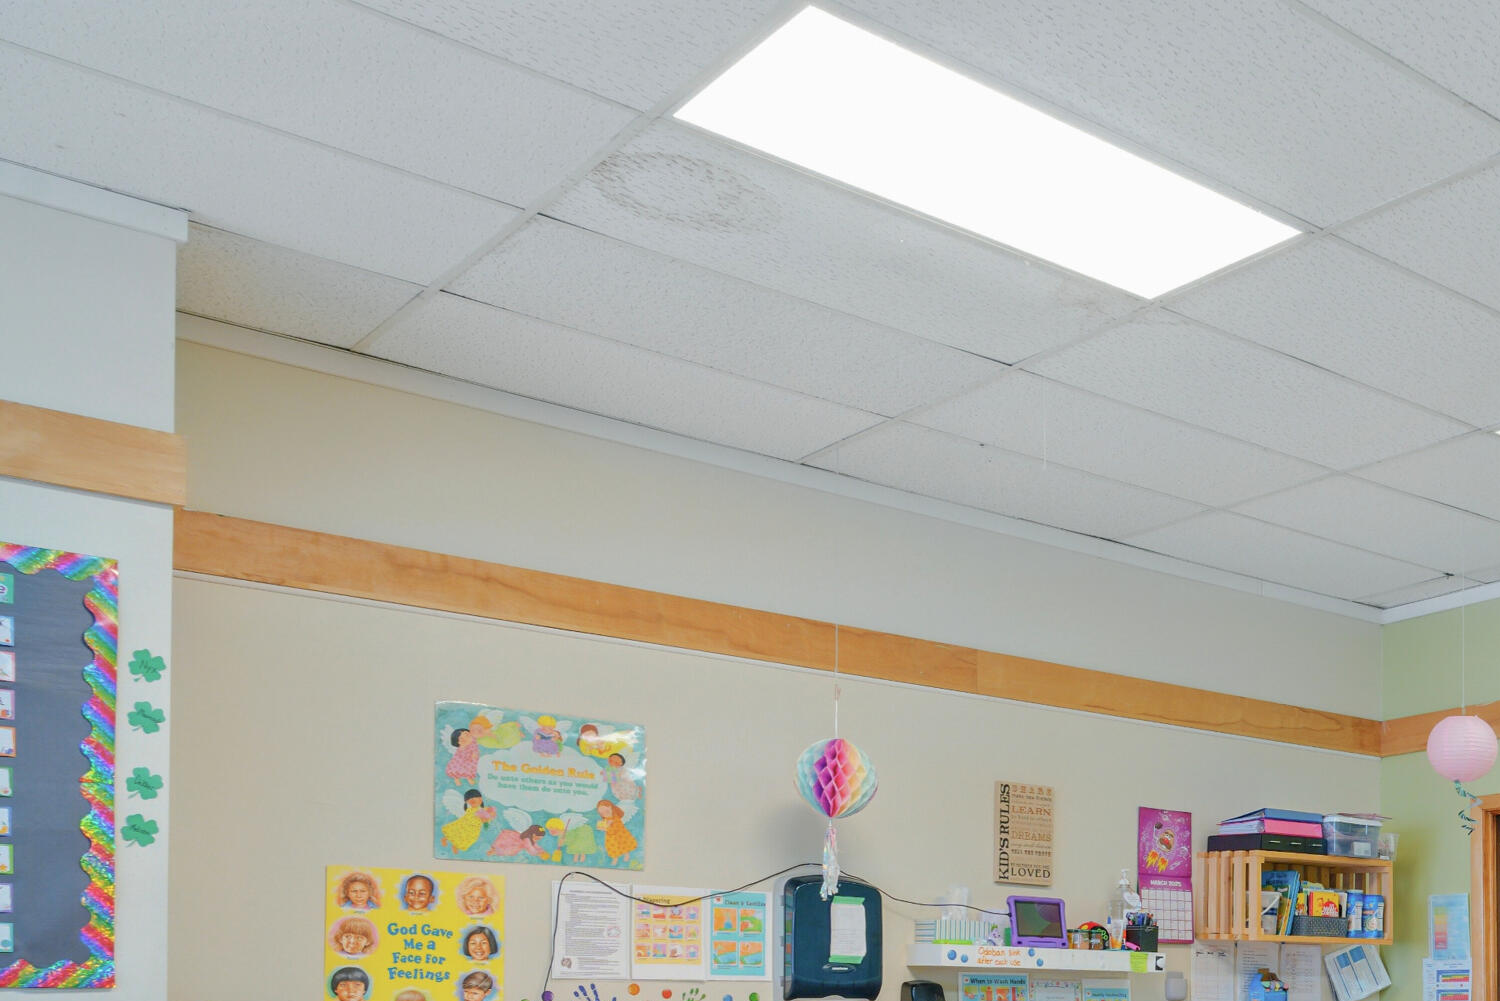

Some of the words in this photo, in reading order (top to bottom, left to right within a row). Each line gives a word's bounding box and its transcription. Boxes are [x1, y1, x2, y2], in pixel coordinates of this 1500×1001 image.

[492, 760, 517, 772] The
[521, 763, 564, 776] Golden
[567, 767, 595, 779] Rule
[1000, 783, 1010, 835] RULES
[1011, 805, 1052, 817] LEARN
[1011, 830, 1052, 842] DREAMS
[999, 837, 1010, 880] KID'S
[1010, 867, 1051, 879] LOVED
[387, 922, 417, 936] God
[421, 923, 453, 939] Gave
[403, 938, 423, 950] Me
[427, 940, 436, 950] a
[392, 952, 422, 964] Face
[387, 966, 450, 982] Feelings
